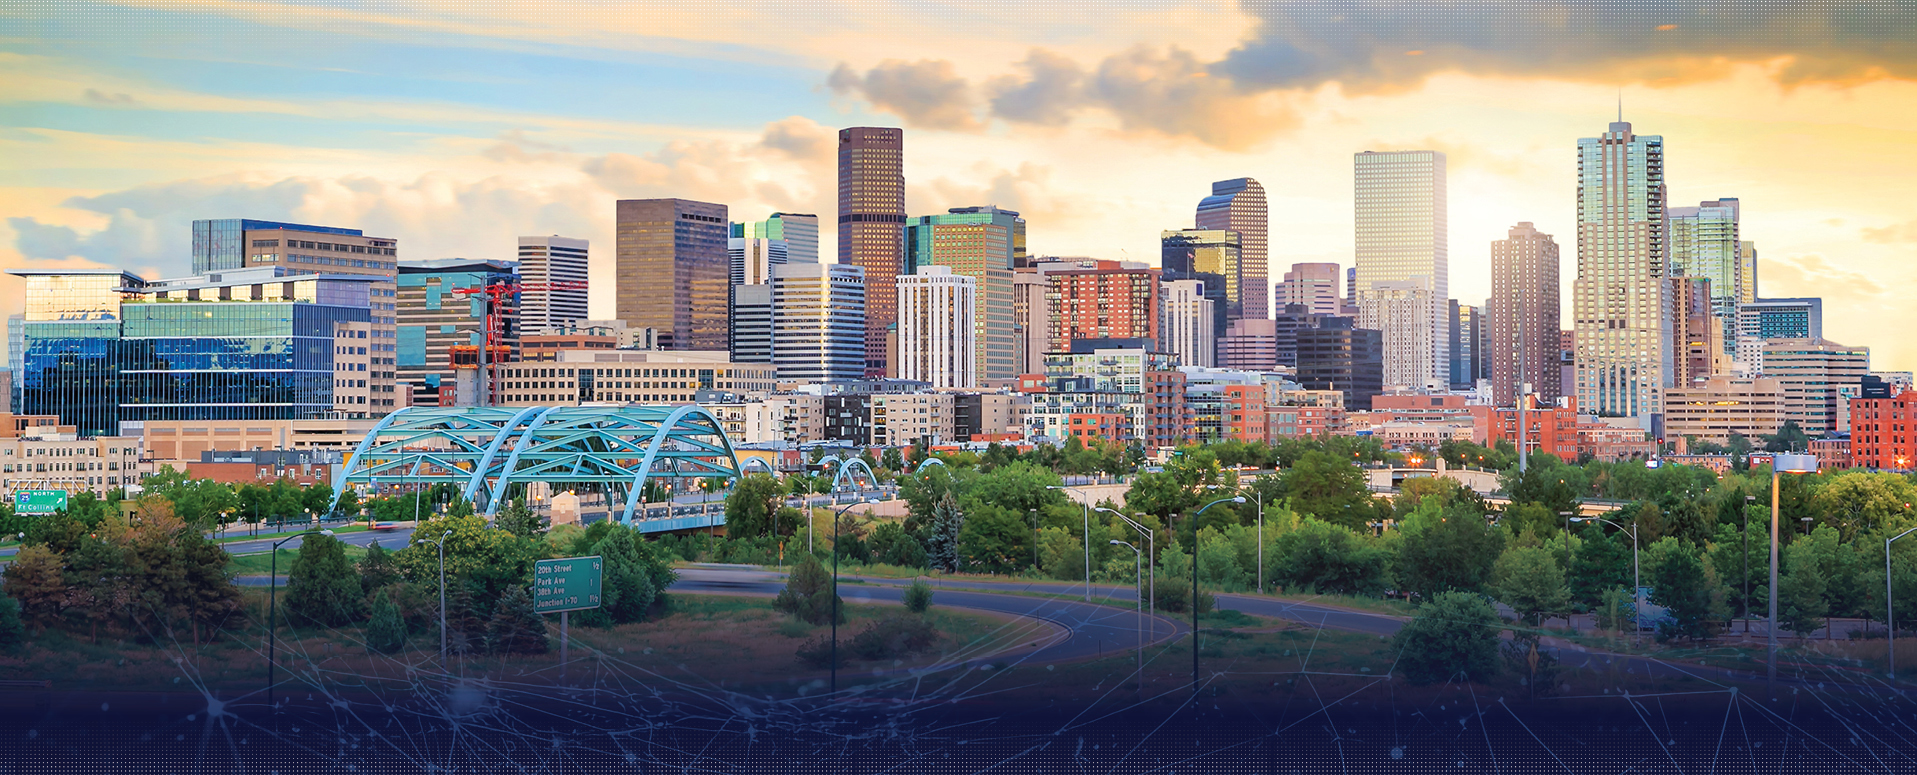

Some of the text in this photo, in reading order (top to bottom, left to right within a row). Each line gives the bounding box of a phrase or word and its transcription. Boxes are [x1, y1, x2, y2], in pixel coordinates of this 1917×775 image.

[538, 566, 552, 574] 20th
[554, 564, 572, 573] Street
[538, 578, 552, 586] Park
[537, 587, 551, 596] 38th
[537, 598, 563, 608] Junction
[565, 596, 578, 604] I-70
